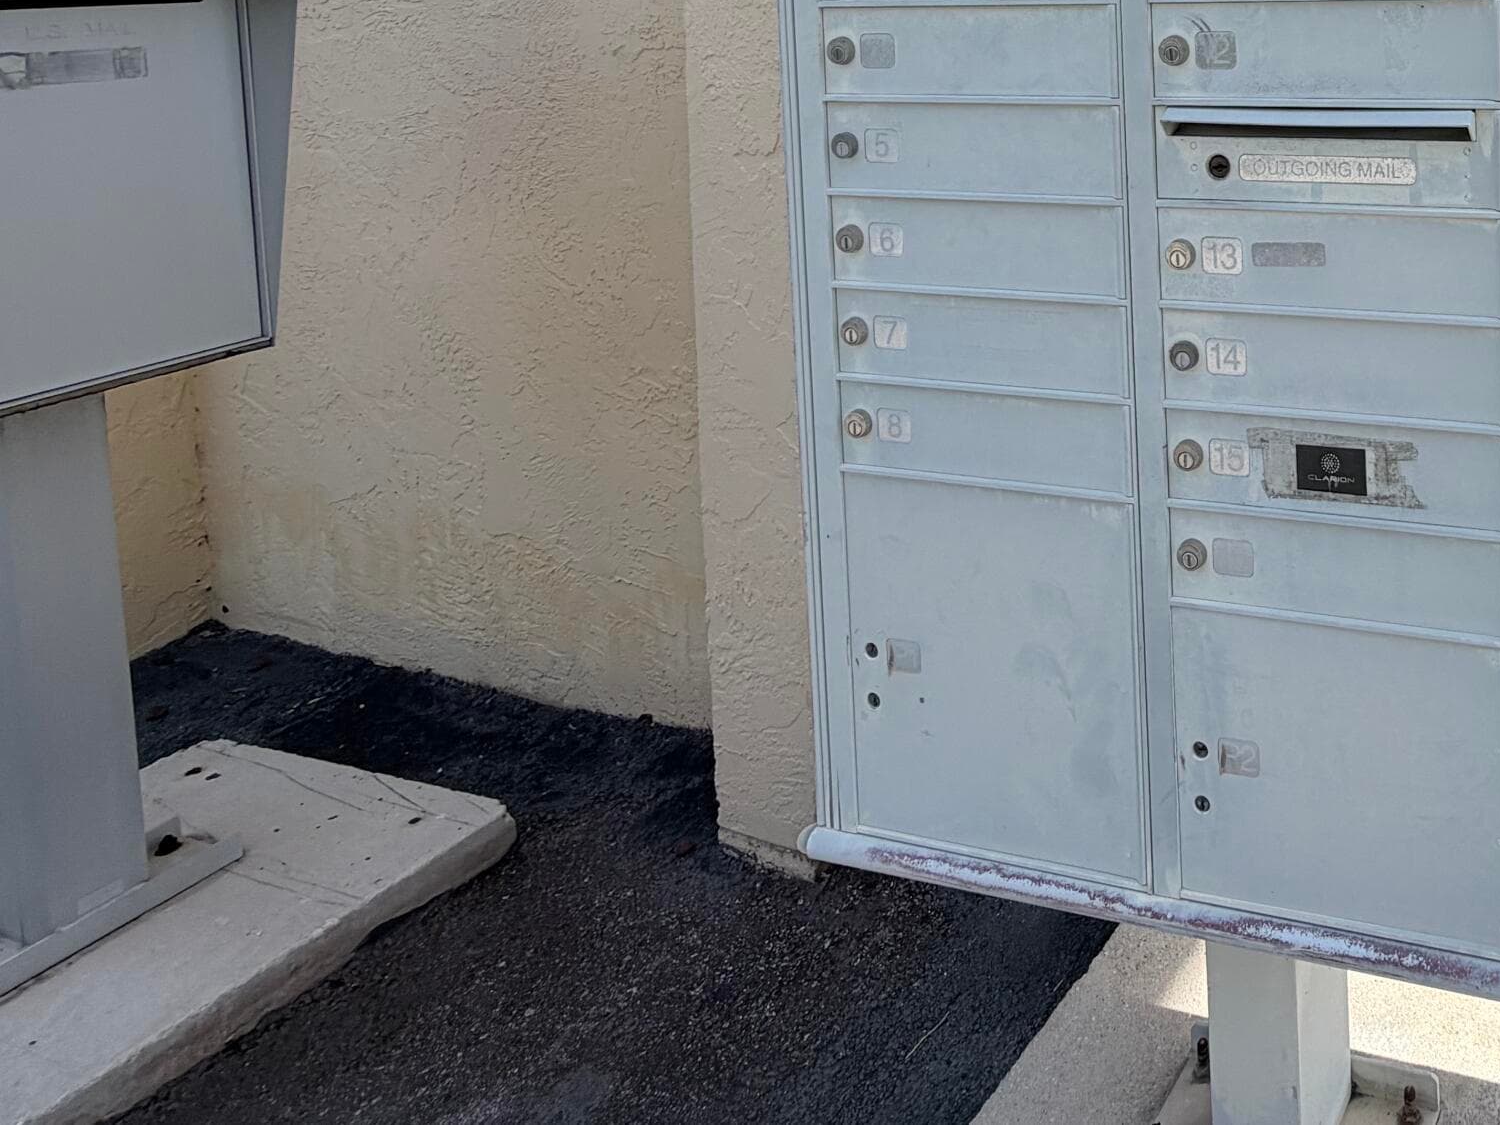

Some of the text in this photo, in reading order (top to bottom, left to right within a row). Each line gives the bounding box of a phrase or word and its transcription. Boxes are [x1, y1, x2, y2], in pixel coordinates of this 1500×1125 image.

[875, 132, 890, 157] 5
[1252, 158, 1402, 179] OUTGOING MAIL
[879, 228, 895, 253] 6
[1207, 243, 1238, 270] 13
[881, 320, 898, 345] 7
[1210, 343, 1241, 371] 14
[888, 414, 903, 438] 8
[1213, 444, 1245, 472] 15
[1306, 473, 1356, 484] CLARION
